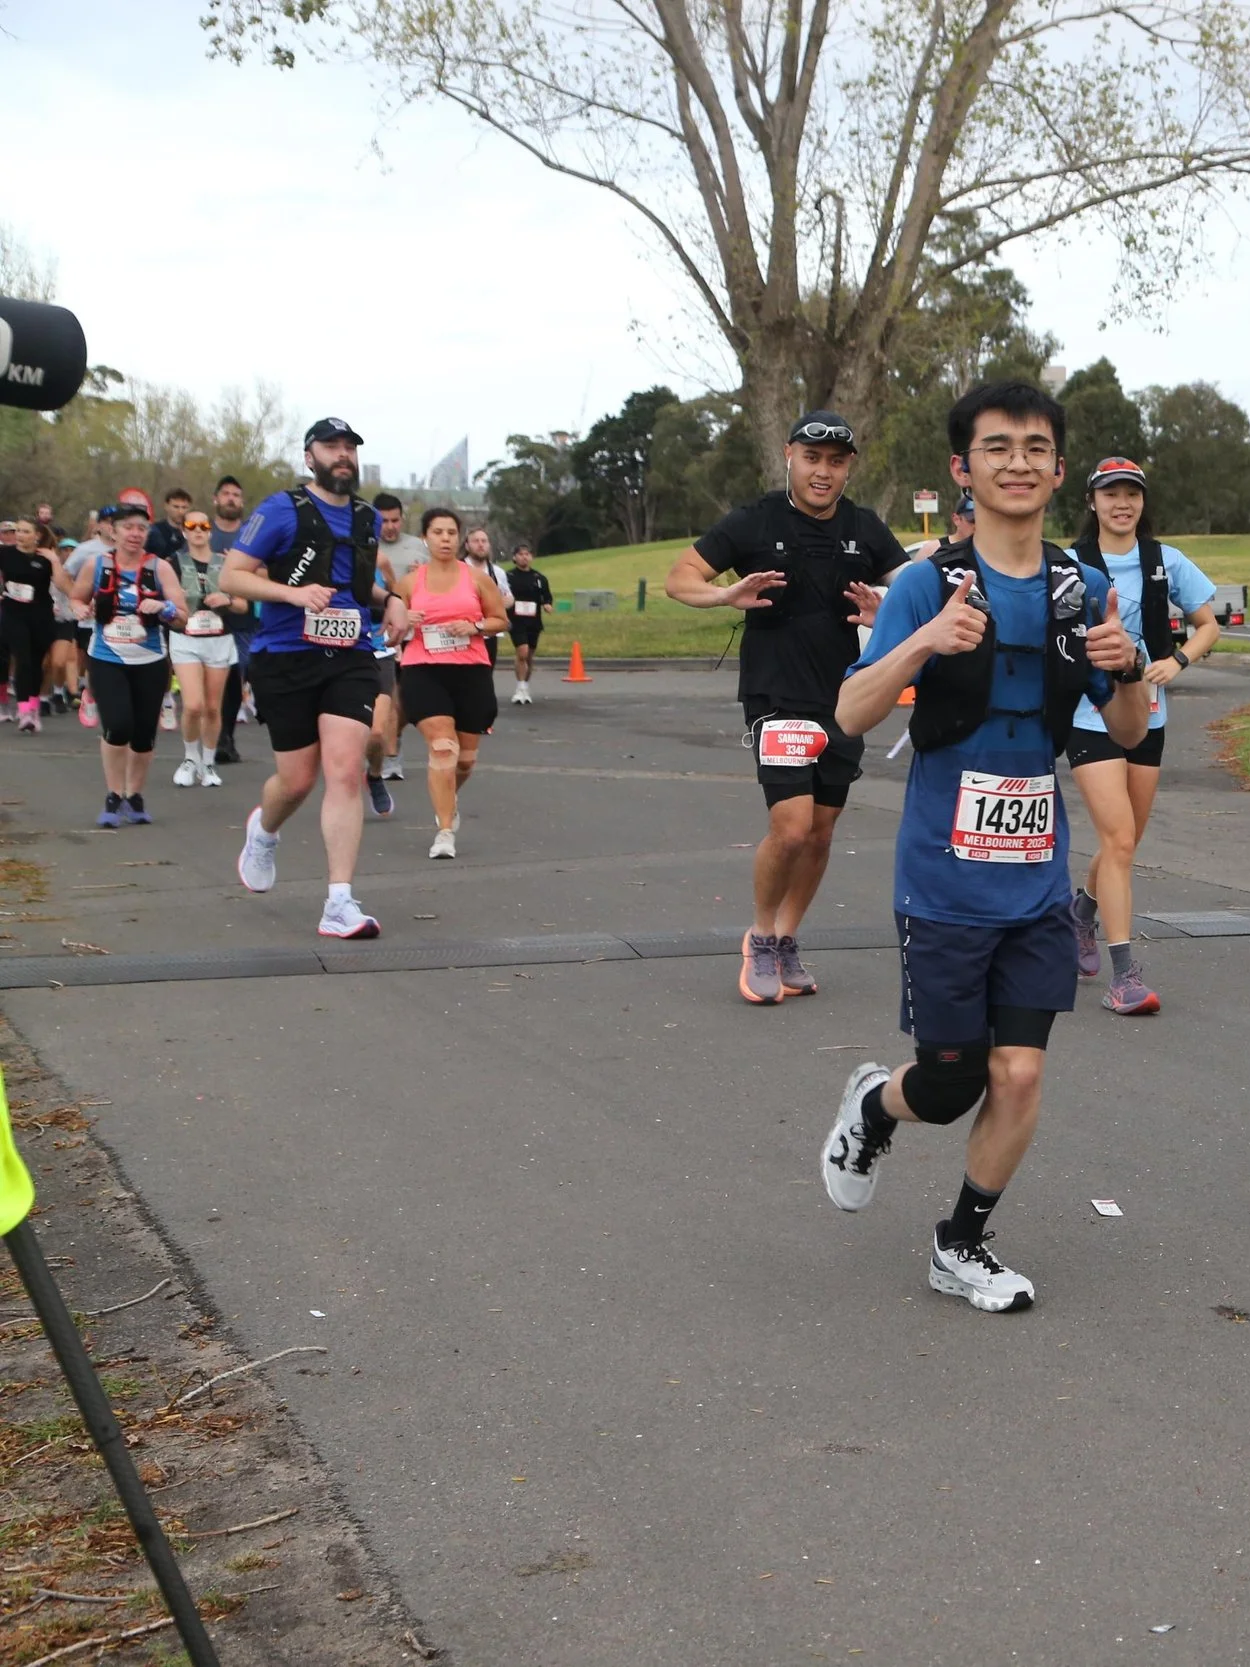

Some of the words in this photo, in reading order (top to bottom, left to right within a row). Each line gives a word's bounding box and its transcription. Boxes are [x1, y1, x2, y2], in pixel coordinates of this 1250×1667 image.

[8, 363, 44, 386] KM
[314, 618, 356, 638] 12333
[777, 733, 814, 745] SAMNANG
[785, 744, 806, 756] 3348
[767, 756, 804, 765] MELBOURNE
[975, 796, 1048, 834] 14349
[963, 834, 1025, 848] MELBOURNE
[1026, 837, 1047, 848] 2025
